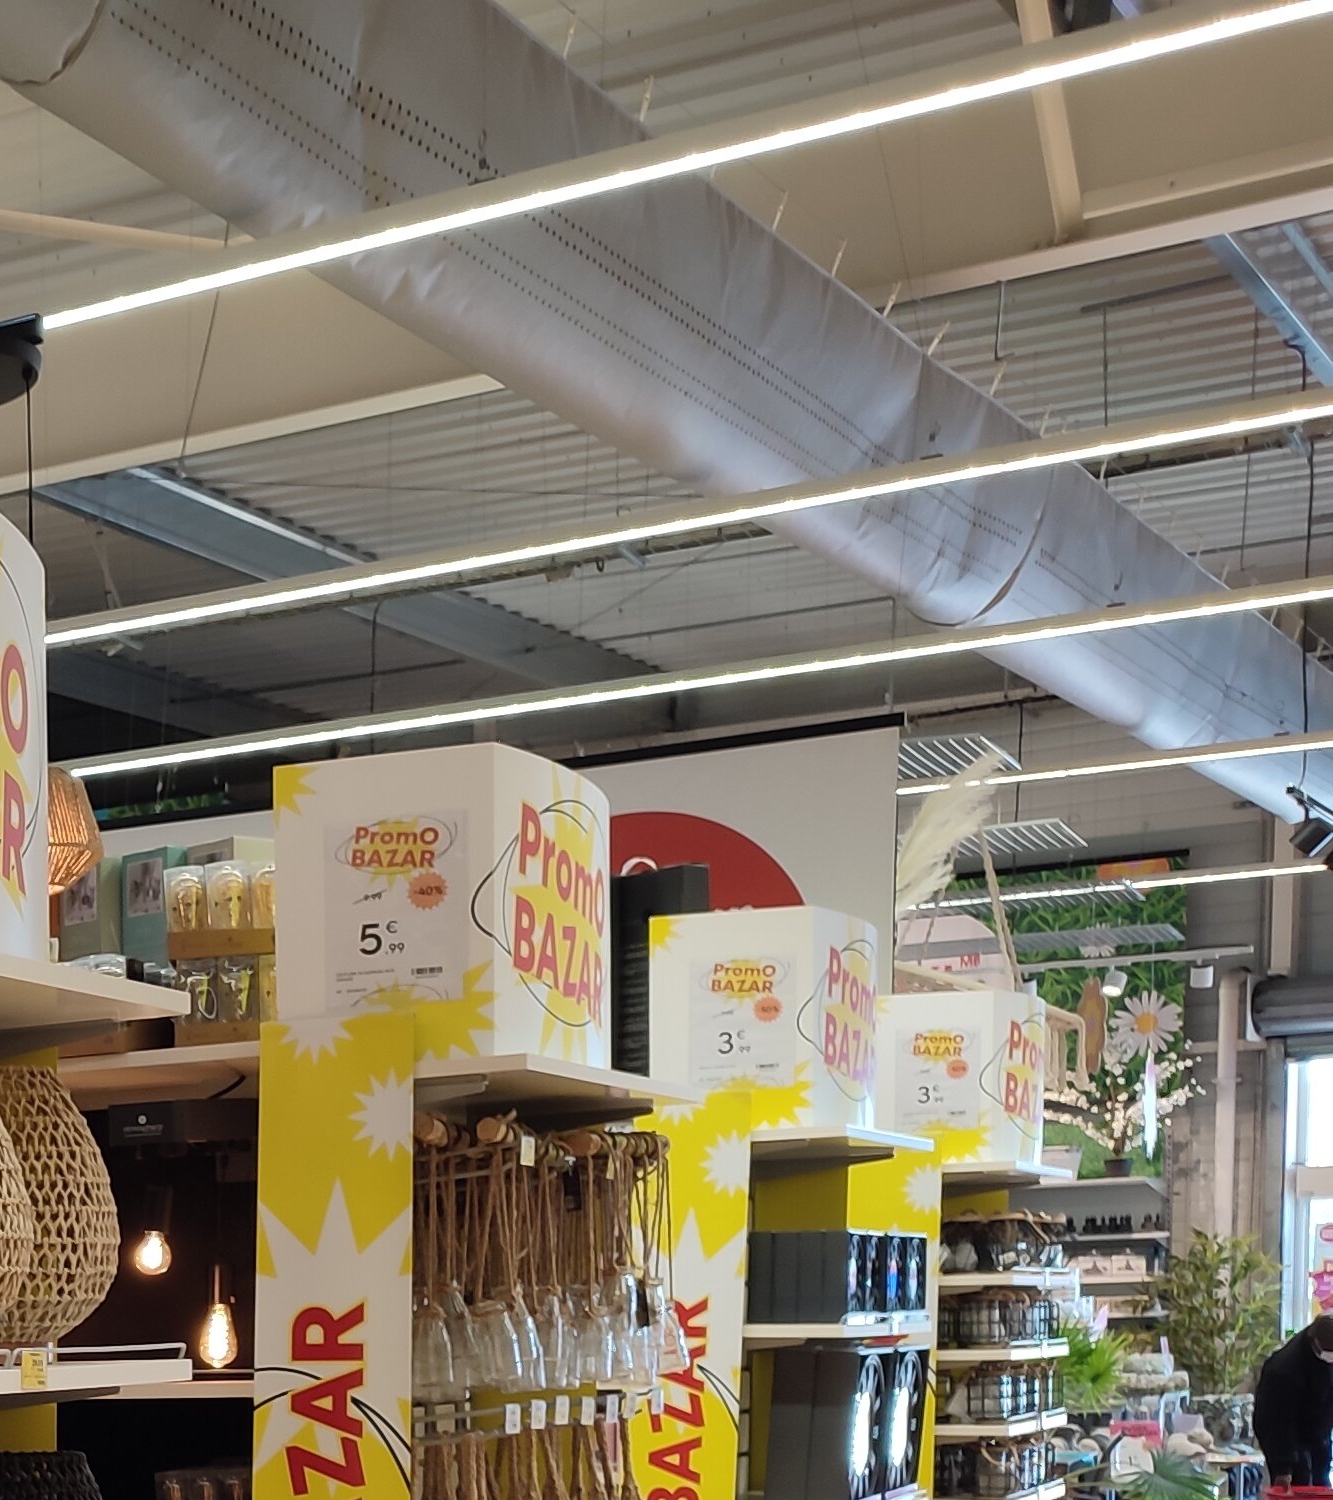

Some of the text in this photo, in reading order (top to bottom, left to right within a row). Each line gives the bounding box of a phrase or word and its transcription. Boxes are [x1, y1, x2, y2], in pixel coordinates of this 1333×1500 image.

[351, 849, 435, 869] BAZAR
[359, 922, 383, 956] 5
[512, 895, 605, 1029] BAZAR
[711, 979, 774, 993] BAZAR
[913, 1045, 962, 1057] BAZAR
